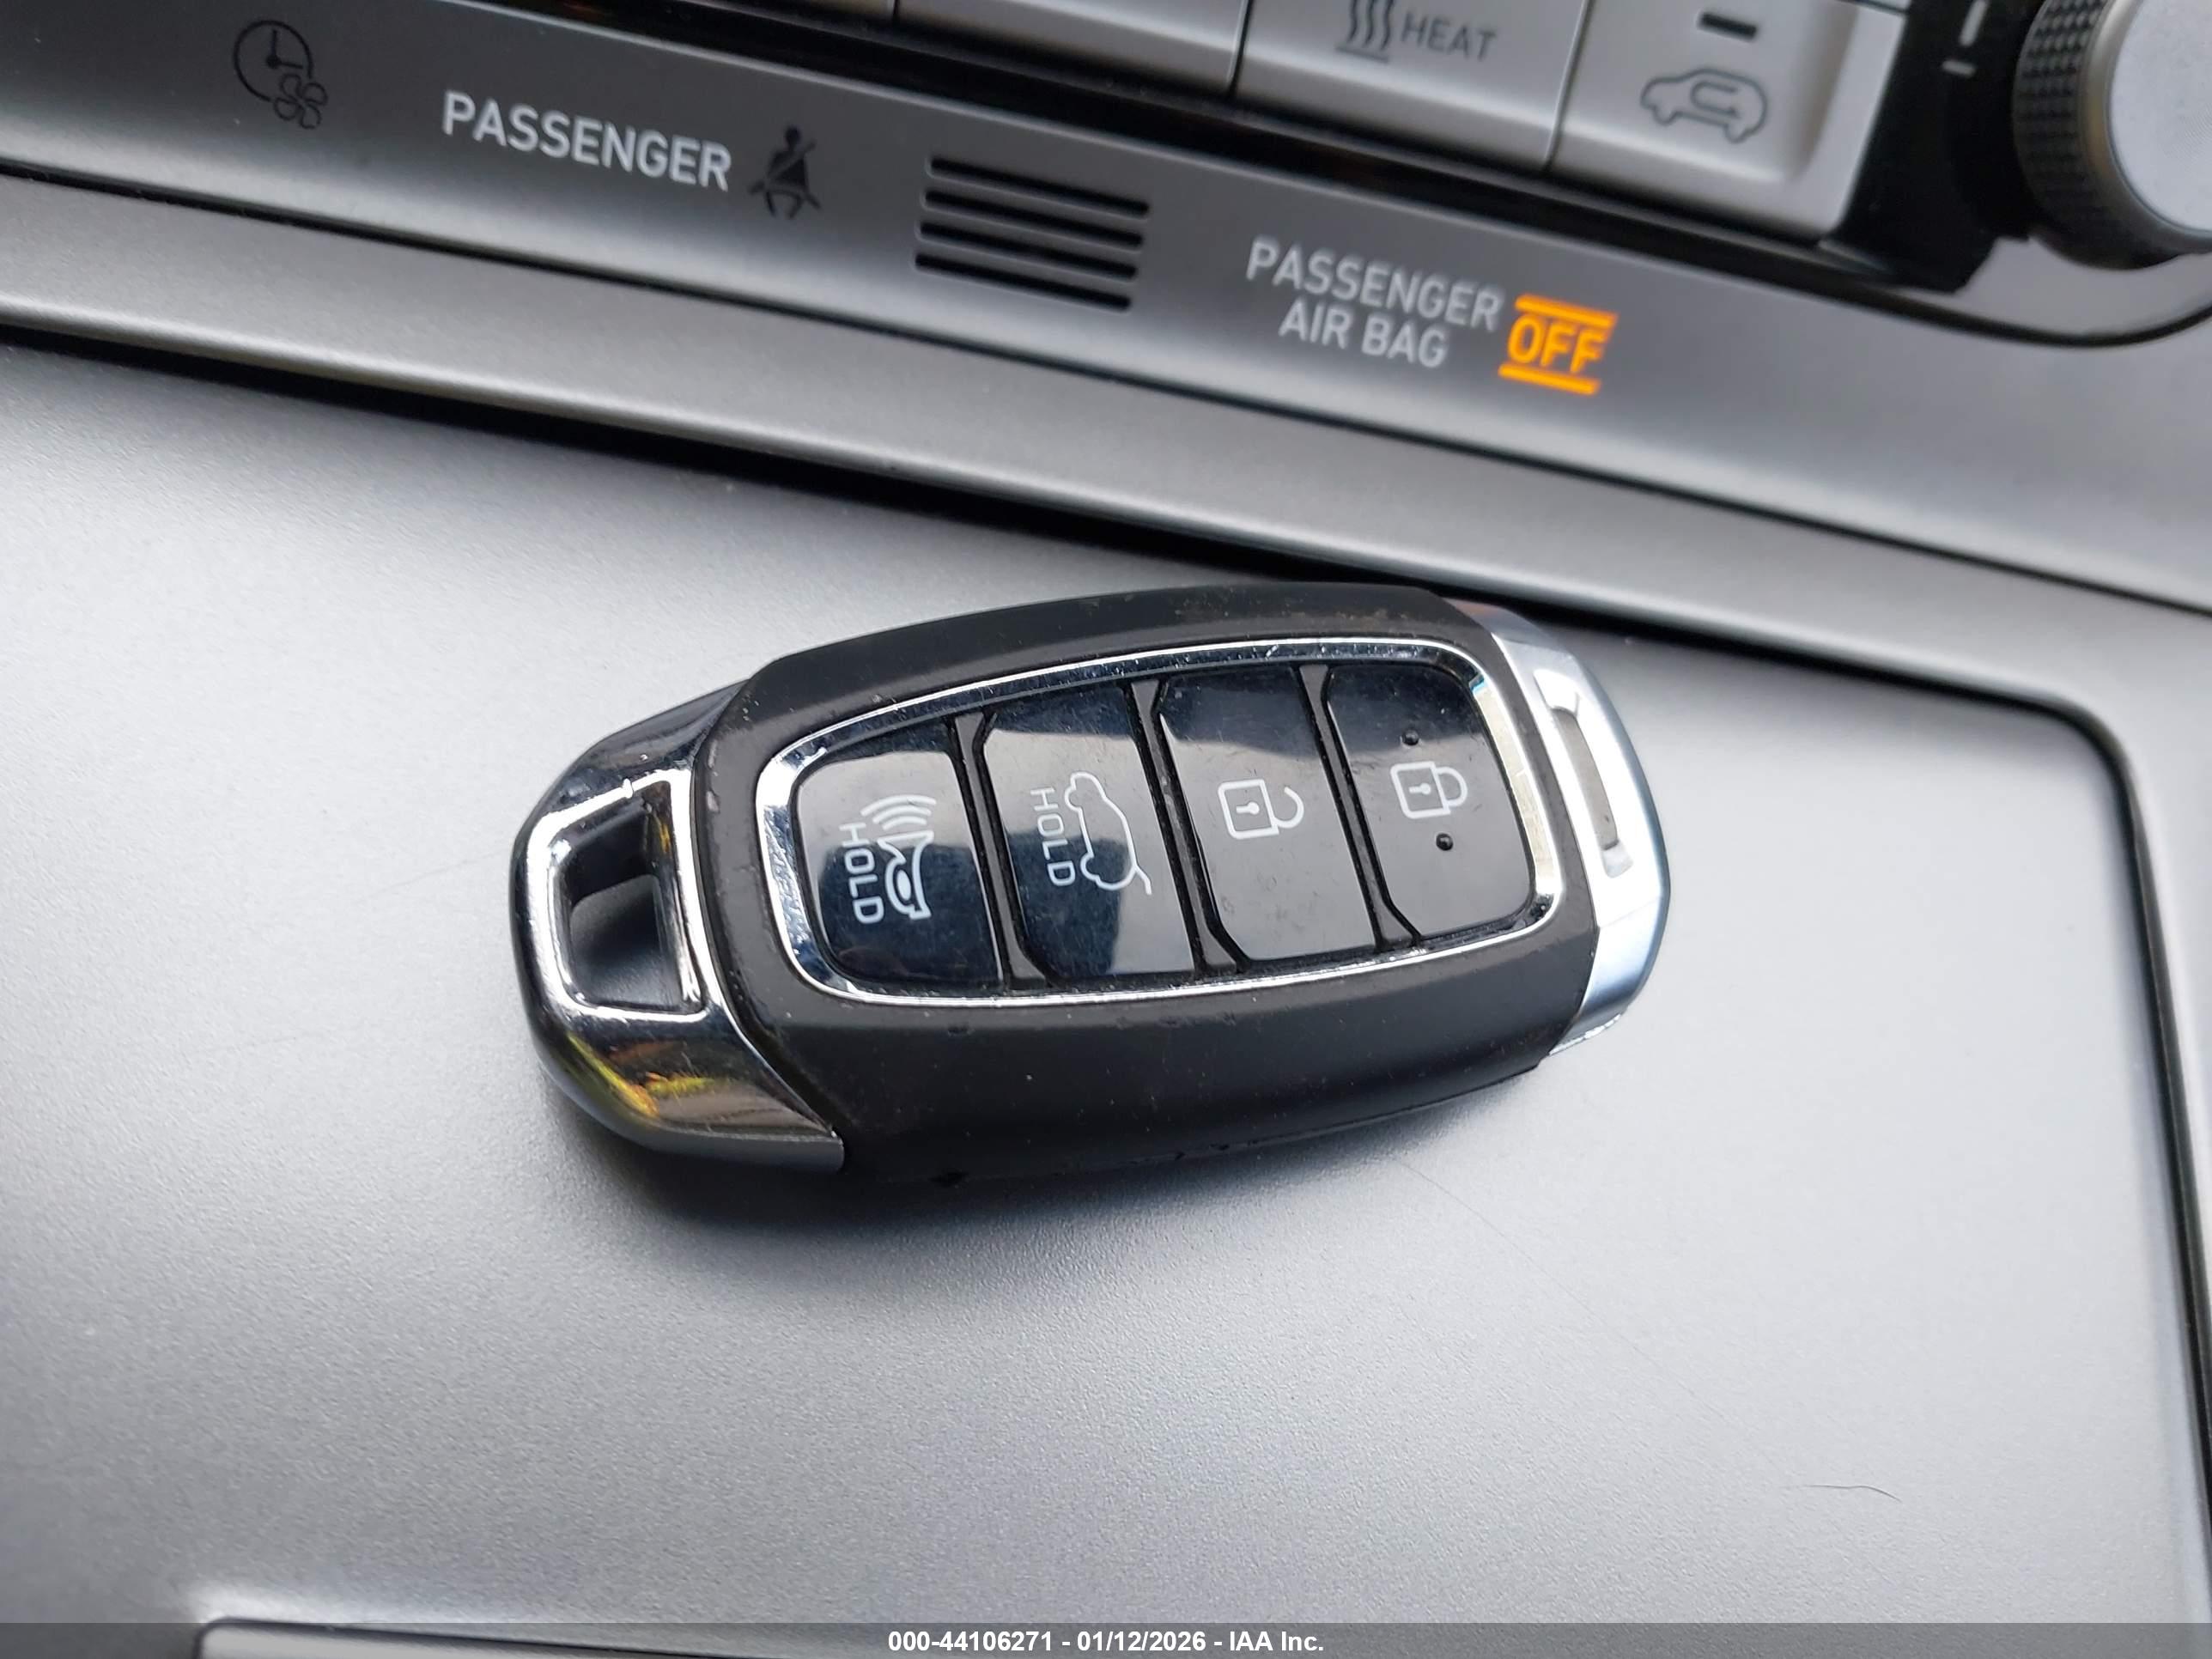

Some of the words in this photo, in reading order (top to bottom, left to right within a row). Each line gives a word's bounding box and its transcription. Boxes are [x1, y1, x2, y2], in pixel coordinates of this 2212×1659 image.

[1401, 13, 1497, 62] HEAT
[441, 90, 732, 191] PASSENGER
[1246, 235, 1504, 332] PASSENGER
[1279, 297, 1353, 349] AIR
[1361, 313, 1449, 368] BAG
[1507, 313, 1608, 374] OFF
[839, 823, 884, 924] HOLD
[1030, 787, 1076, 886] HOLD
